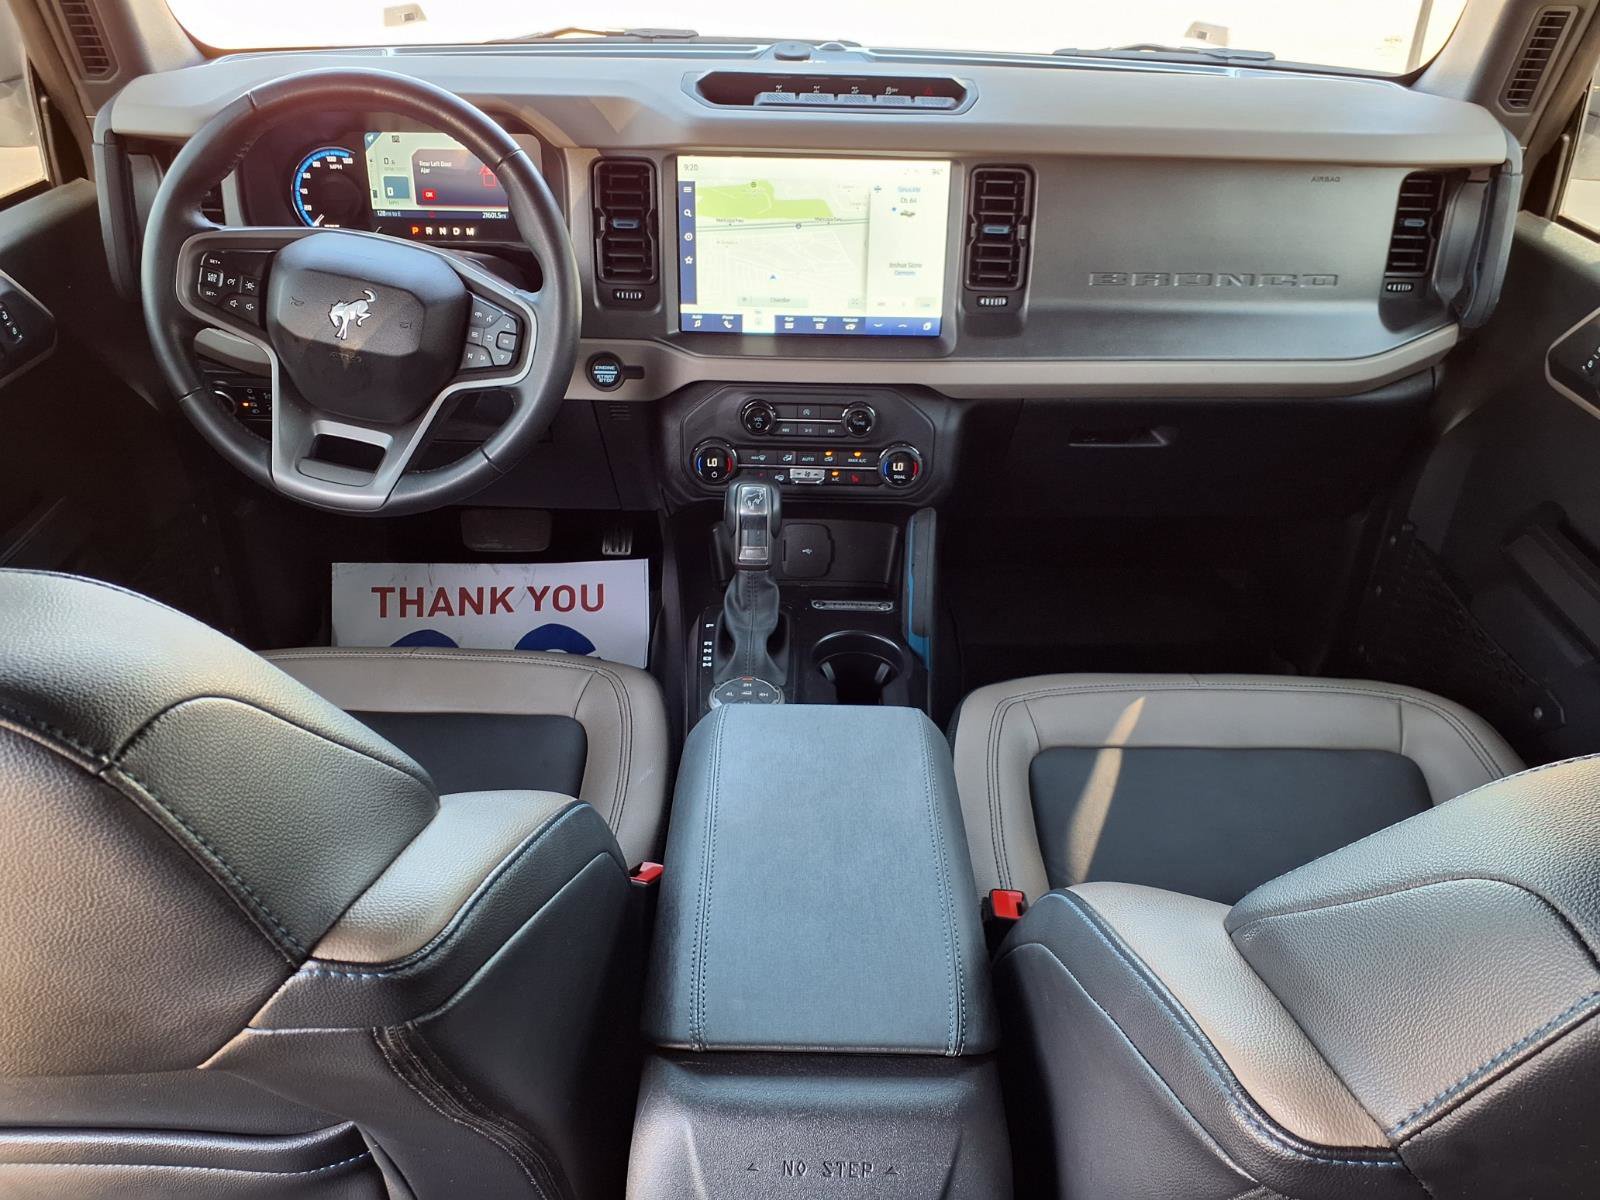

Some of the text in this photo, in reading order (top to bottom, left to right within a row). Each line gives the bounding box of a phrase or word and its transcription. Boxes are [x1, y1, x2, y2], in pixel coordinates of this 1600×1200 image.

[1310, 175, 1341, 183] AIRBAG
[425, 227, 433, 235] R
[439, 228, 447, 236] N
[453, 228, 460, 236] D
[466, 228, 475, 236] M
[1088, 271, 1339, 287] BRONCO
[892, 463, 904, 472] LO
[371, 583, 605, 619] THANK YOU
[782, 1160, 874, 1178] NO STEP
